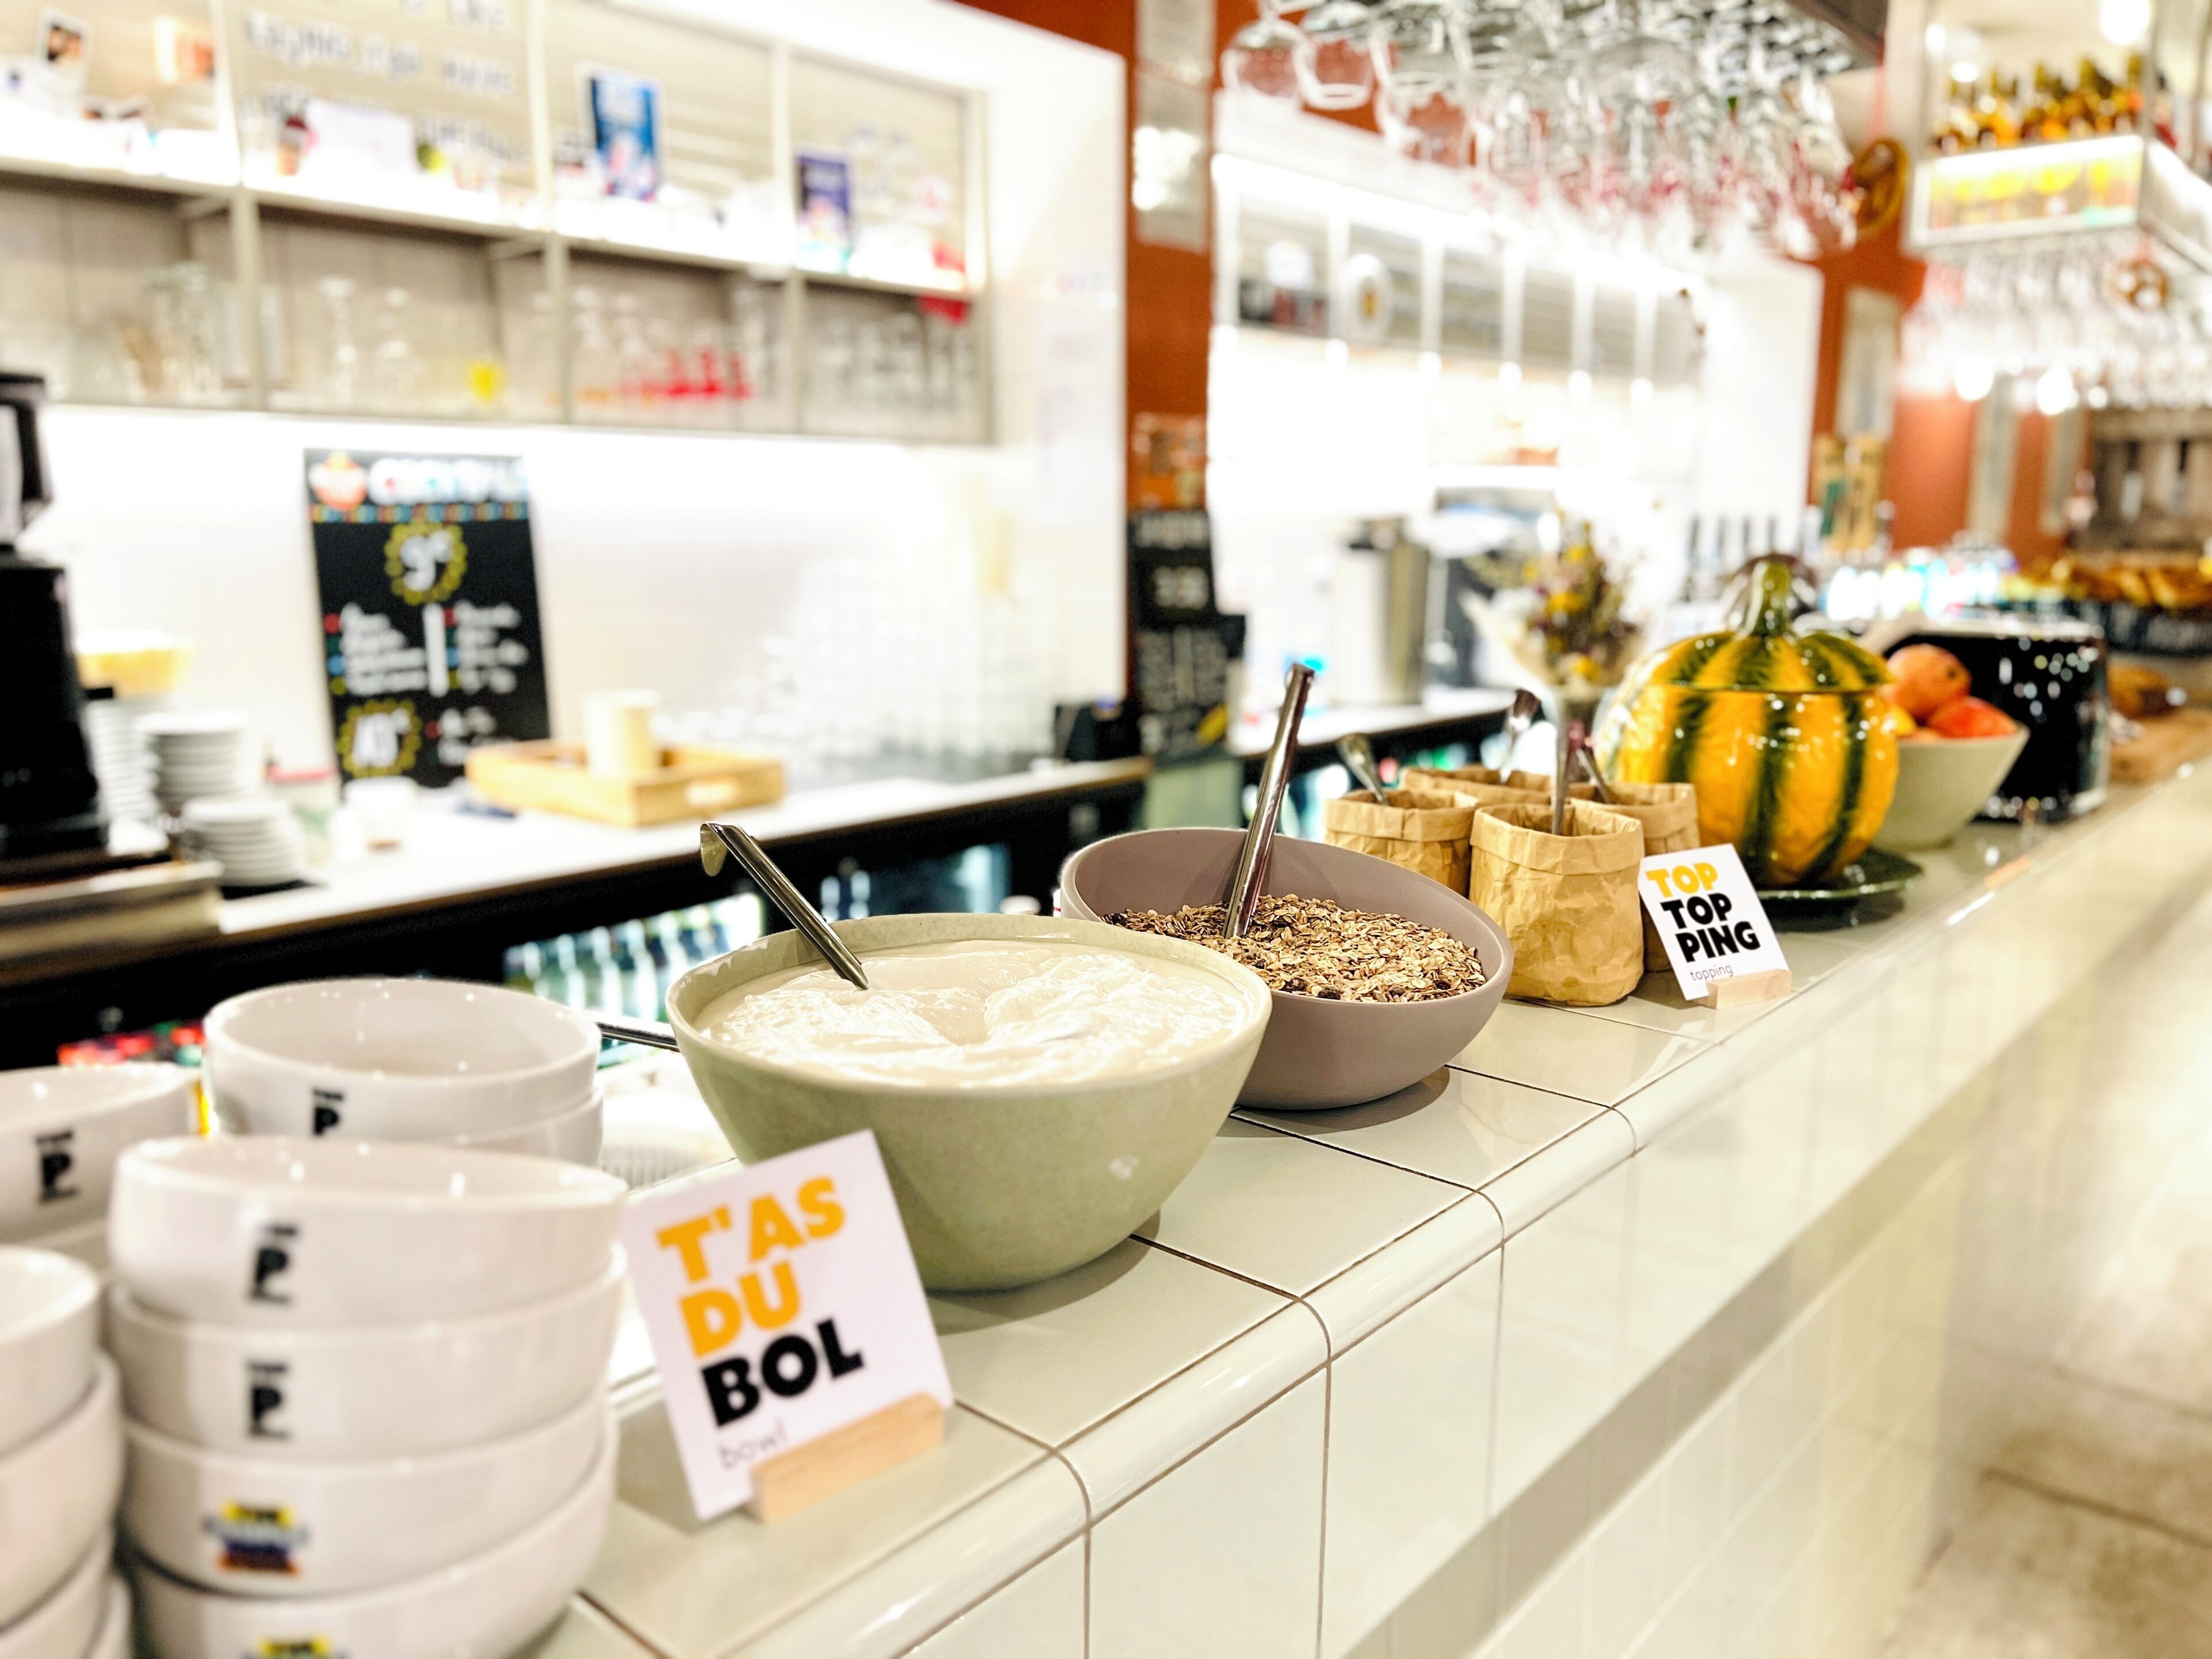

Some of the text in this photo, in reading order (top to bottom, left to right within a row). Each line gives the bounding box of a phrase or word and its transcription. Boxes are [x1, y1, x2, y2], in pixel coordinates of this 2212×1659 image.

[1646, 862, 1718, 898] TOP
[1660, 892, 1732, 929] TOP
[1675, 921, 1761, 963] PING
[1690, 964, 1733, 982] topping
[656, 1176, 846, 1283] T'AS
[679, 1260, 801, 1359] DU
[700, 1318, 865, 1427] BOL
[718, 1418, 787, 1470] bowl
